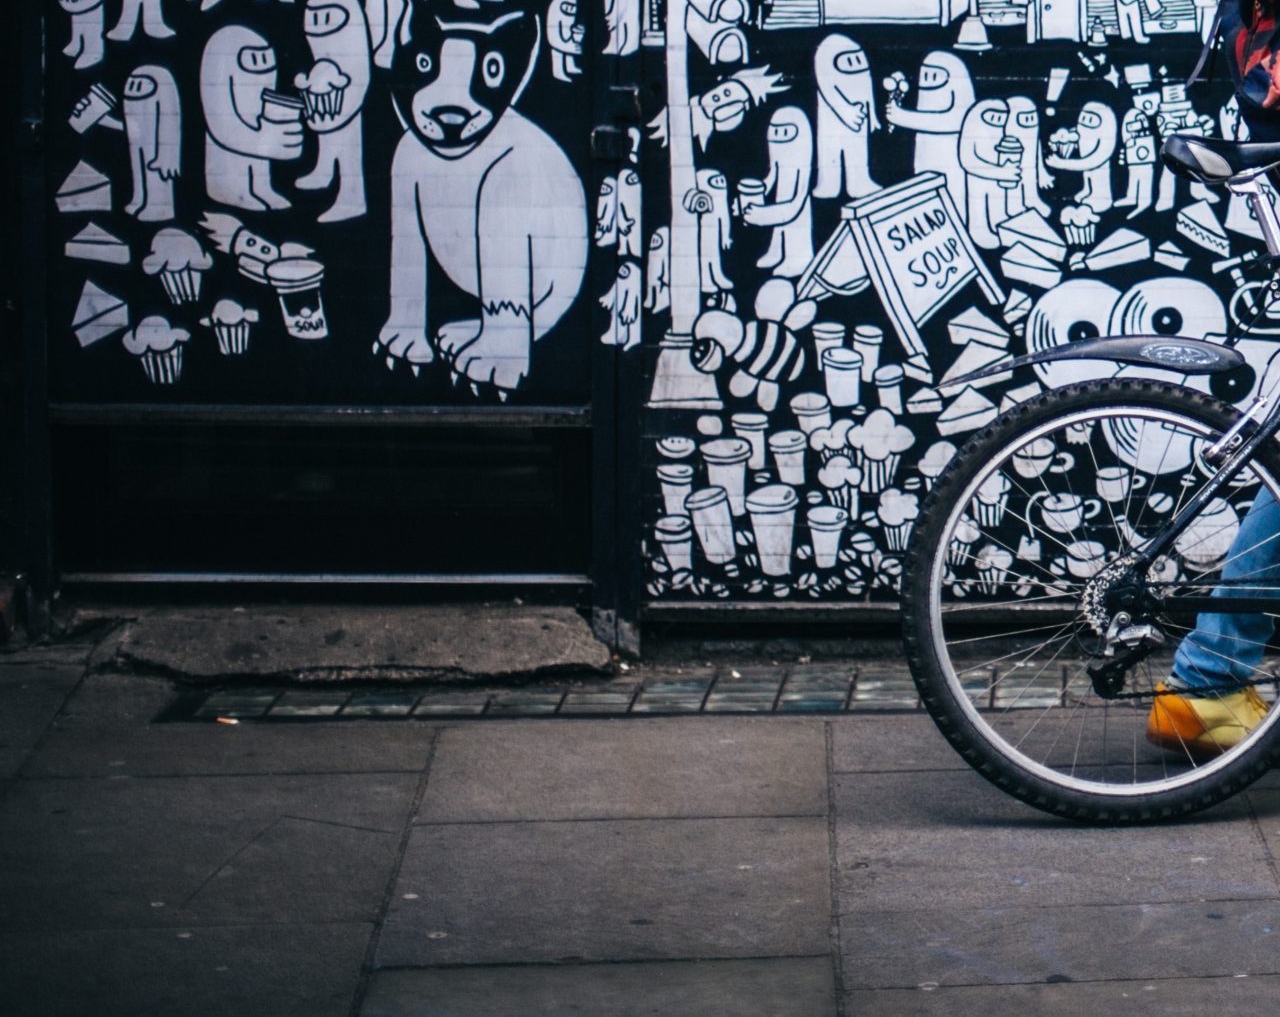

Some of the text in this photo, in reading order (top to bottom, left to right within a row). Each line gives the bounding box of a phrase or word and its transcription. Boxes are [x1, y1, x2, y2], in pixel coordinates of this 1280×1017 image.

[887, 209, 946, 251] SALAD
[908, 237, 960, 288] SOUP
[294, 317, 324, 333] SOUP
